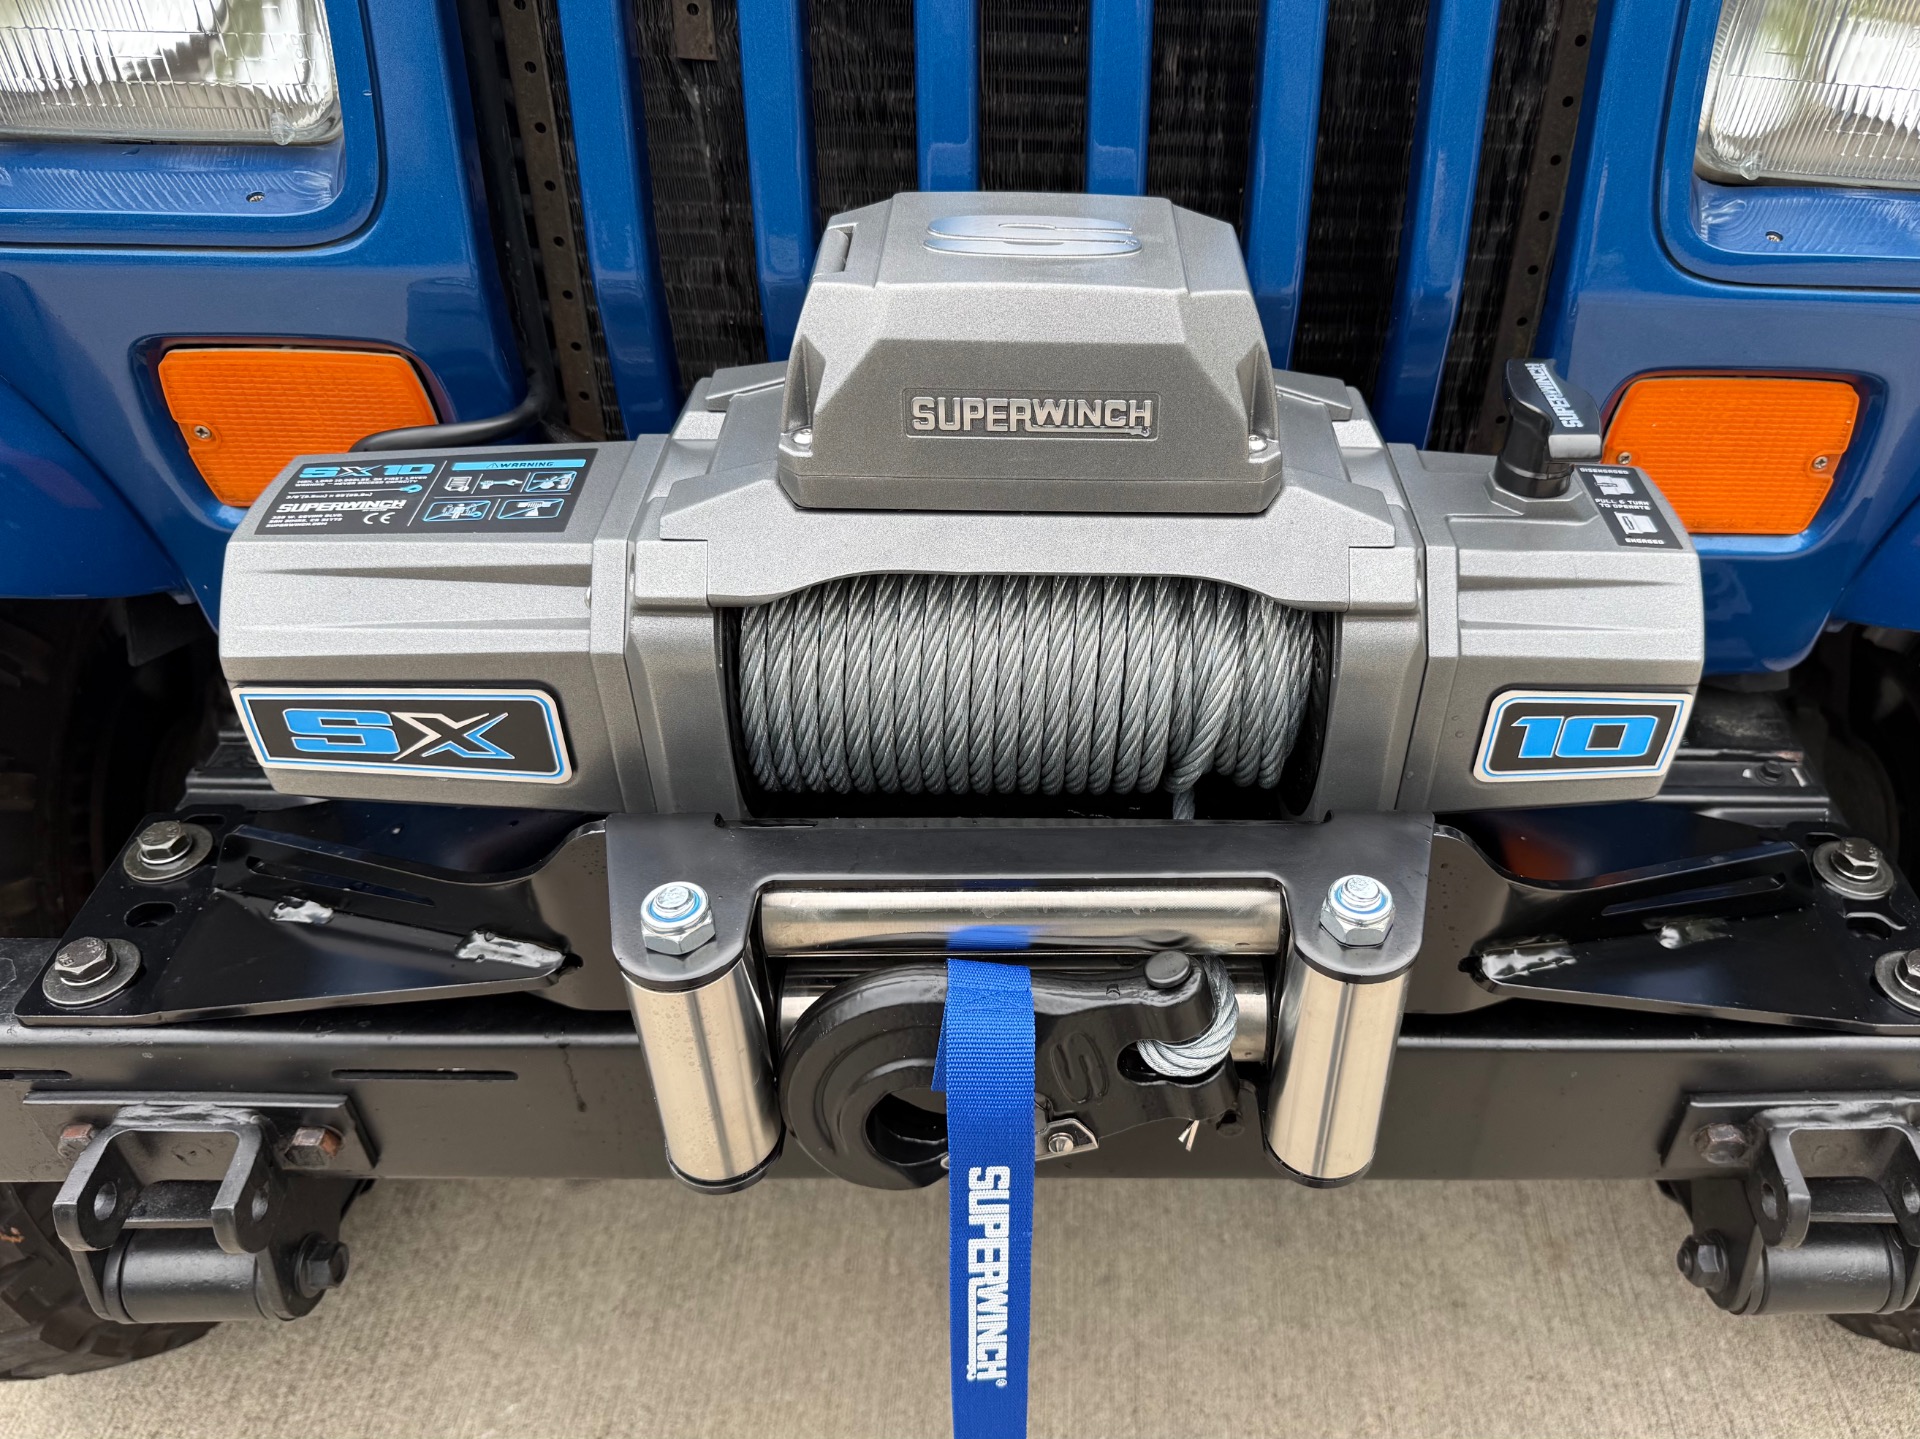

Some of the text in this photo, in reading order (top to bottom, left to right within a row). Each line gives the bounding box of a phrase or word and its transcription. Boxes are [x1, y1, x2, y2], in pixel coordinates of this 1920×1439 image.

[1524, 363, 1584, 428] SUPERWINCH
[911, 396, 1153, 437] SUPERWINCH
[1579, 467, 1630, 475] DISENGAGED
[276, 500, 407, 513] SUPERWINCH
[1612, 503, 1652, 511] OPERATE
[1624, 537, 1665, 545] ENGAGED
[282, 708, 516, 762] SX
[1511, 715, 1659, 758] 10
[967, 1165, 1011, 1382] SUPERWINCH
